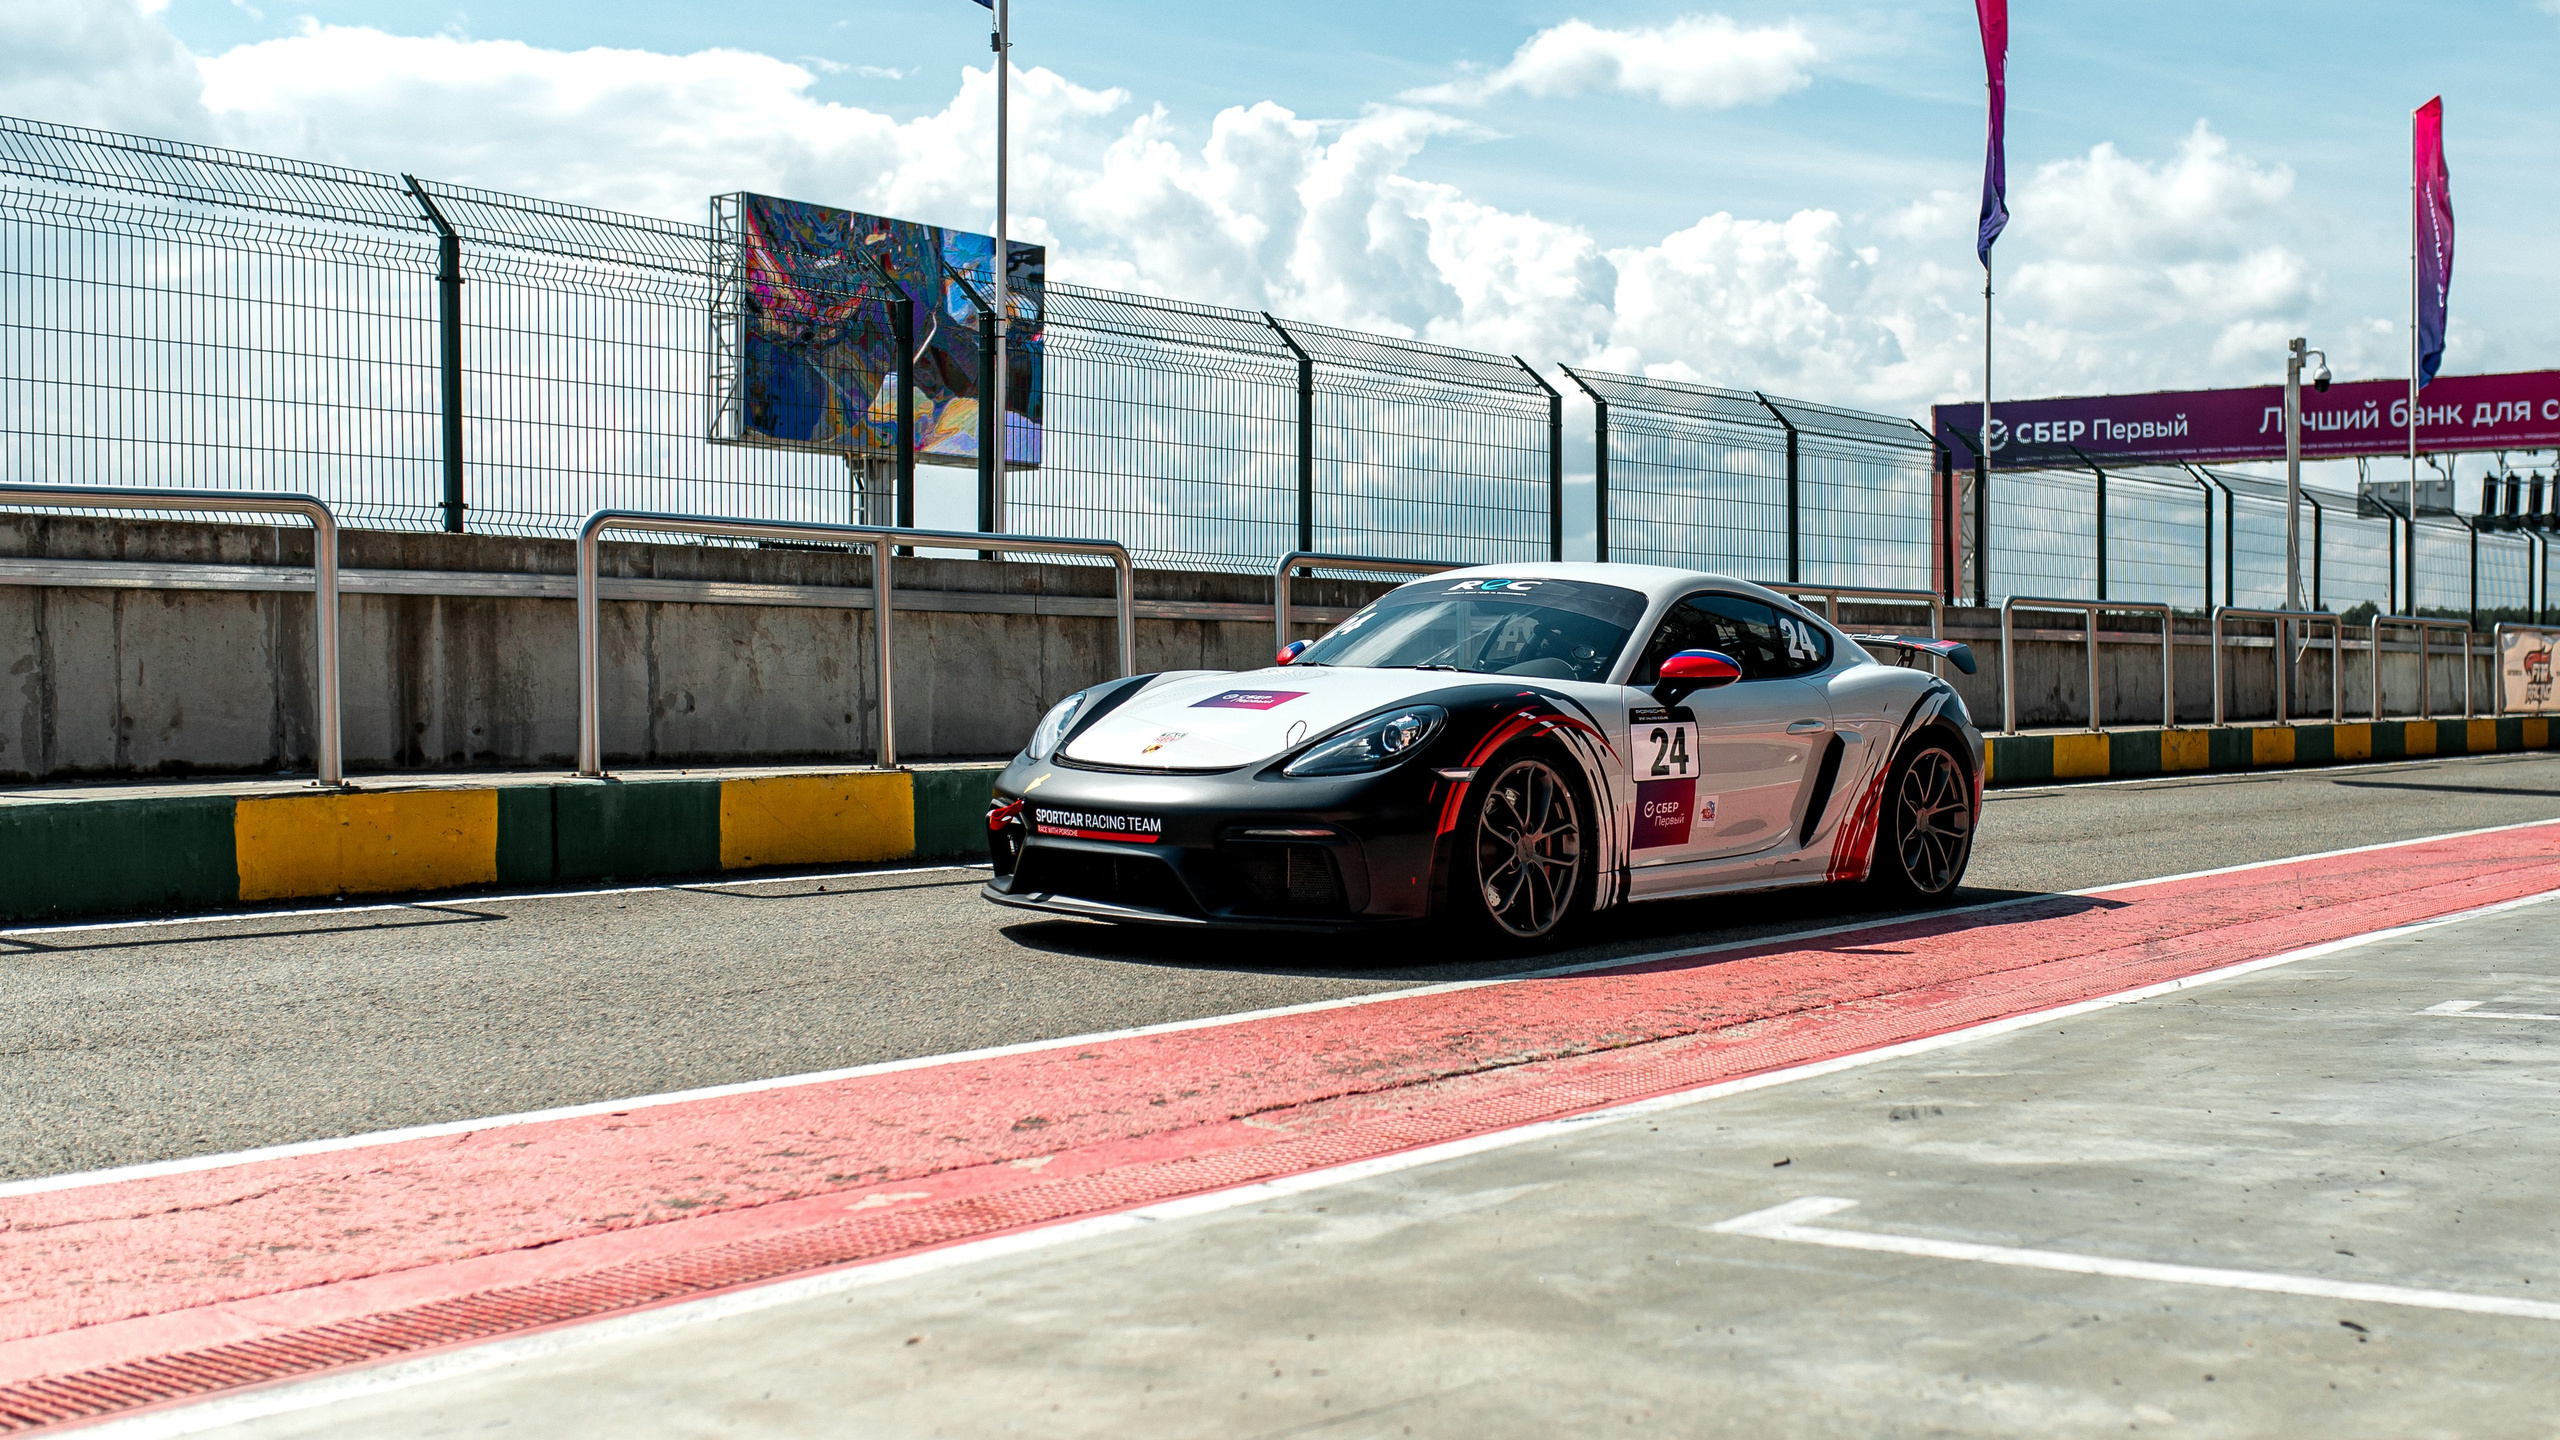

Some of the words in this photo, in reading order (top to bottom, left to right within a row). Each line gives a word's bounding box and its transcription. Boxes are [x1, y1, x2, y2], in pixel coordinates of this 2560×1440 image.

[2015, 420, 2086, 444] СБЕР
[2093, 413, 2188, 443] Первый
[2259, 400, 2379, 434] Лчший
[2389, 398, 2463, 428] банк
[2471, 400, 2531, 428] для
[1779, 617, 1818, 661] 24
[1649, 727, 1690, 776] 24
[1036, 808, 1083, 827] SPORTCAR
[1085, 814, 1125, 830] RACING
[1127, 816, 1162, 832] TEAM
[1654, 813, 1685, 828] Первый
[1655, 801, 1679, 814] СБЕР
